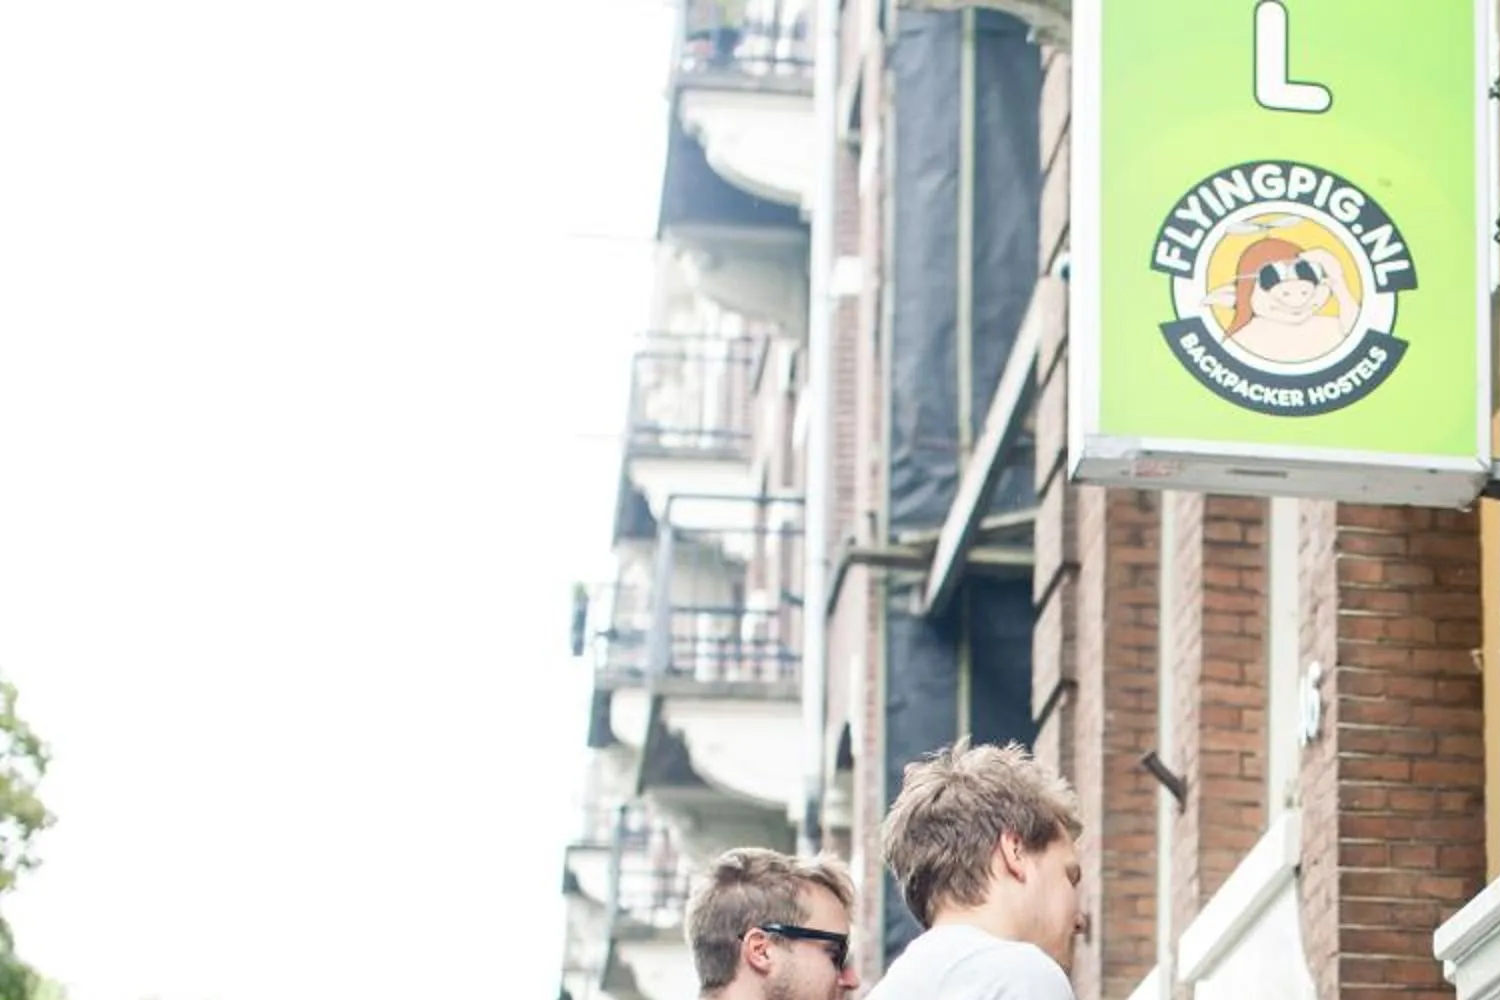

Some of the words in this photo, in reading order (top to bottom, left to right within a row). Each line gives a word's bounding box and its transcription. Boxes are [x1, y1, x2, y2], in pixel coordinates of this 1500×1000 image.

[1254, 0, 1332, 113] L
[1155, 164, 1411, 287] FLYINGPIG.NL
[1180, 332, 1304, 406] BACKPACKER
[1309, 346, 1388, 404] HOSTELS
